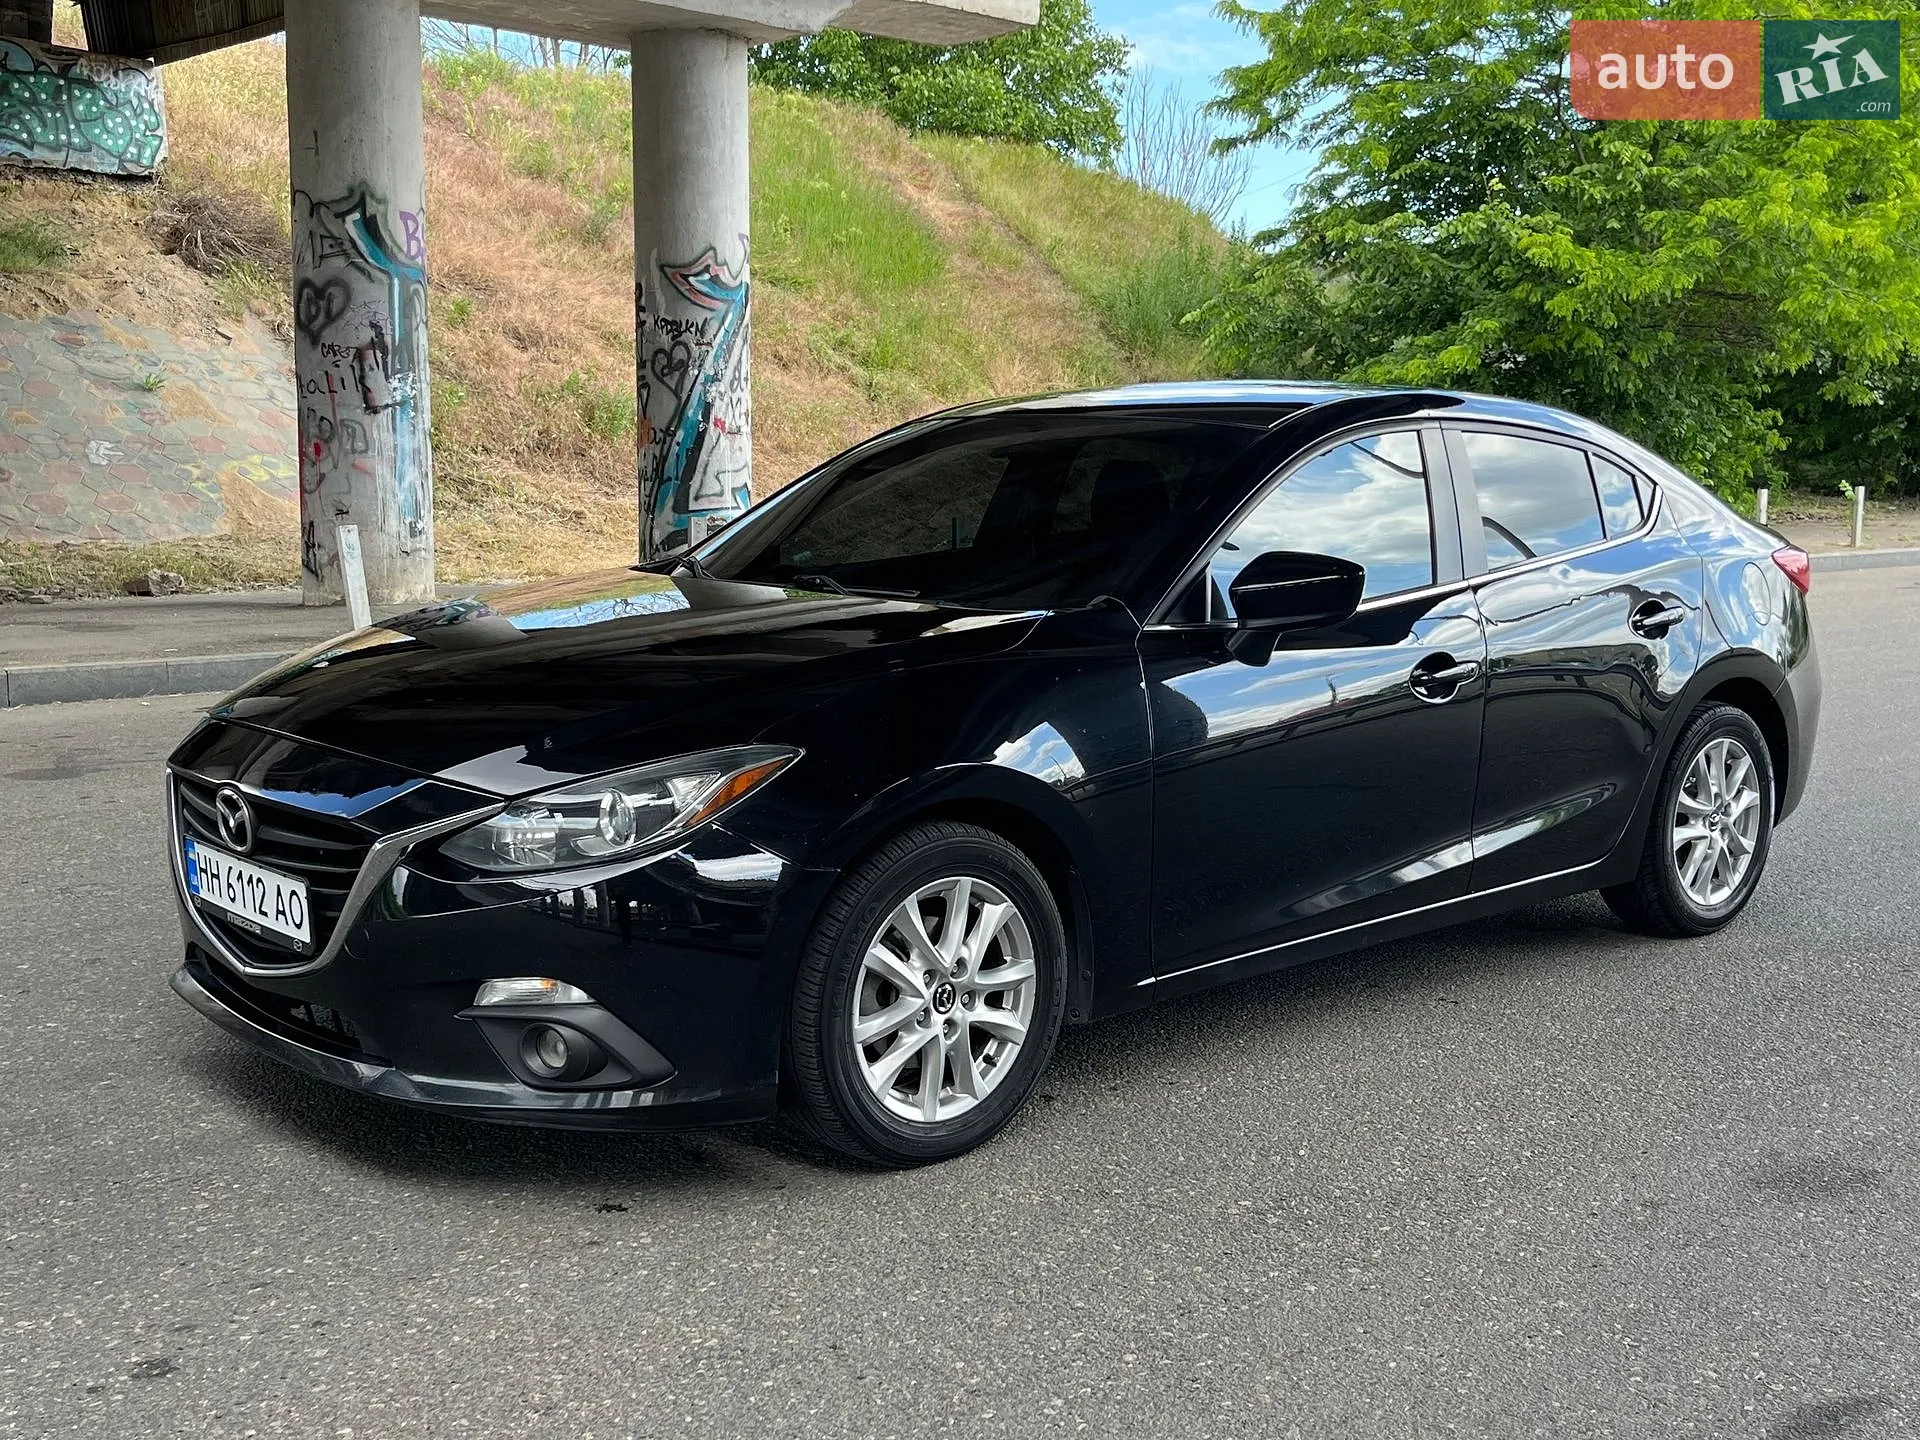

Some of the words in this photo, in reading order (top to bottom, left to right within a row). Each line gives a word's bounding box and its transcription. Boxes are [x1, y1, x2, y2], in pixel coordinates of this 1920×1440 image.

[196, 851, 222, 898] HH
[226, 865, 269, 918] 6112
[275, 883, 304, 930] AO
